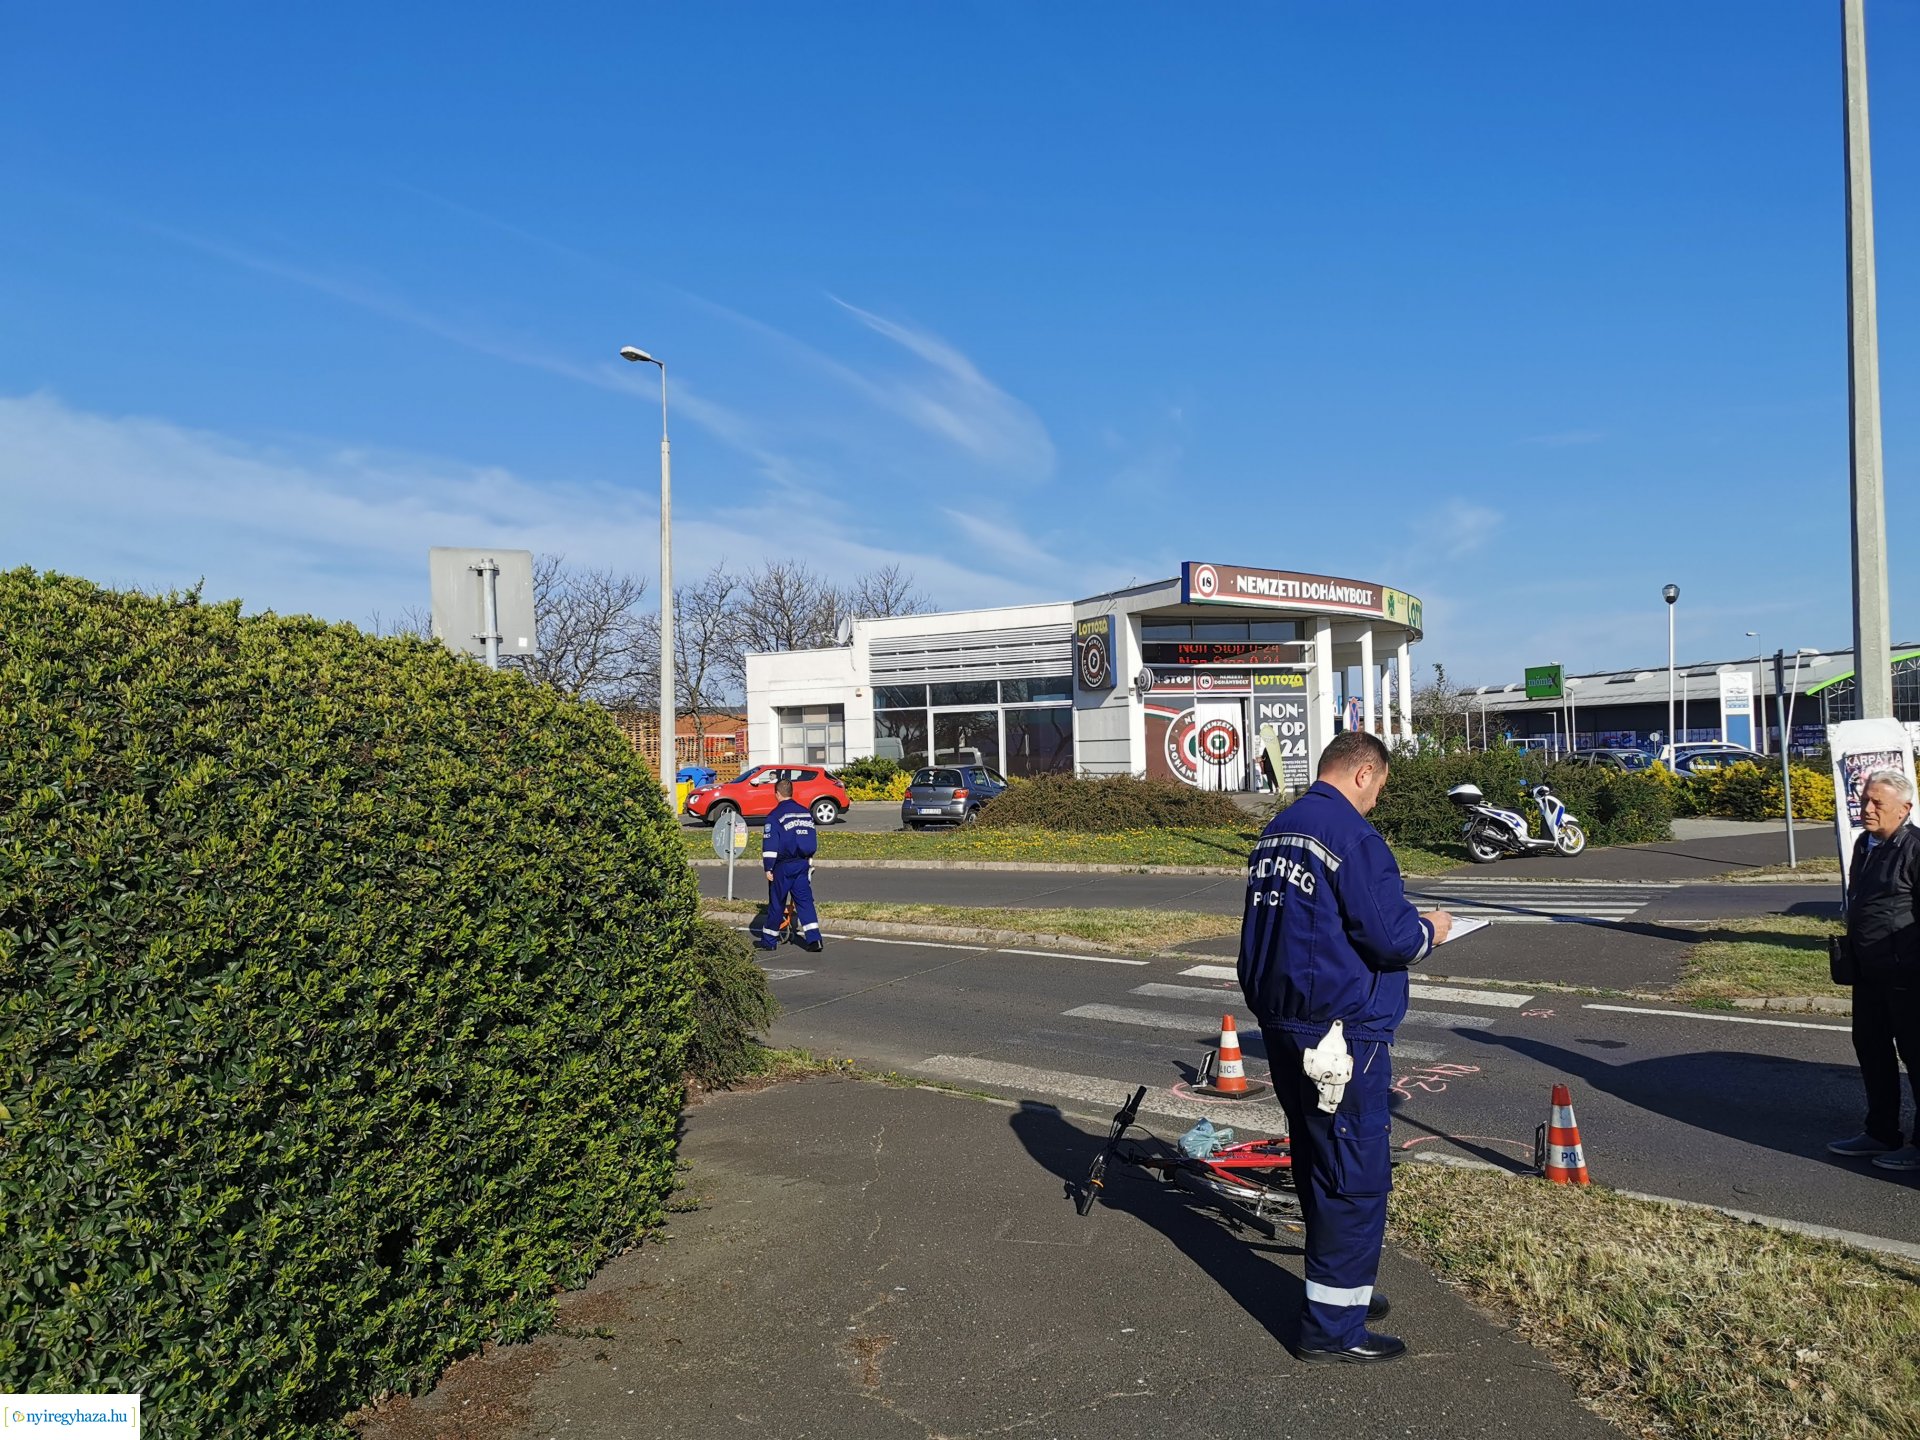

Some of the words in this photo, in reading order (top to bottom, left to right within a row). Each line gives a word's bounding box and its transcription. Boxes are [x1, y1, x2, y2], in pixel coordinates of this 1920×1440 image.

[1202, 576, 1212, 588] 18
[1236, 574, 1300, 598] NEMZETI
[1302, 580, 1373, 606] DOHÁNYBOLT
[1259, 702, 1304, 719] NON-
